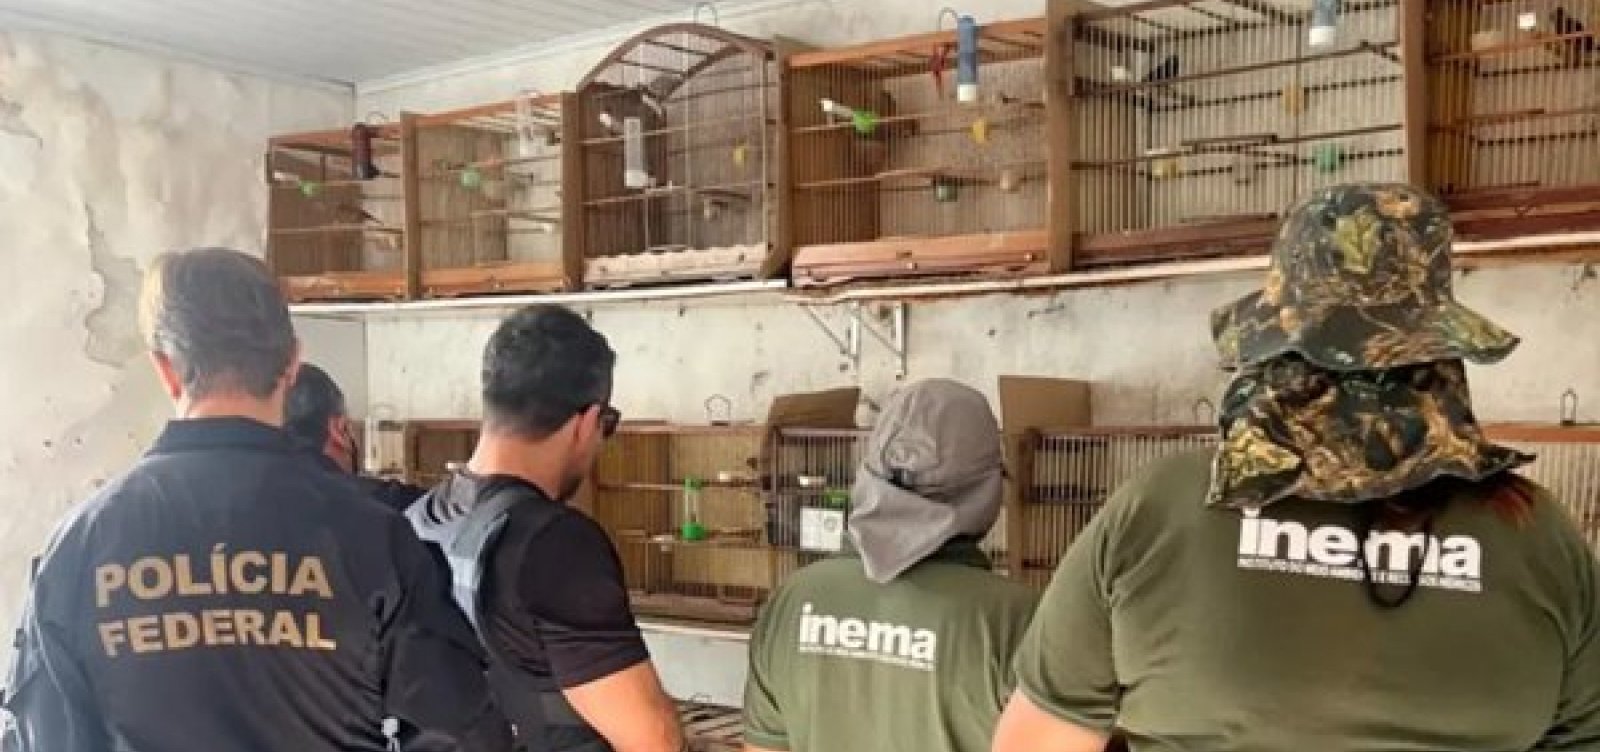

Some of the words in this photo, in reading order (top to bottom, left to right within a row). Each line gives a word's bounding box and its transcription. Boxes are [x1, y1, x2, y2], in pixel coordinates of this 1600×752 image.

[1239, 507, 1481, 579] inema
[95, 542, 333, 607] POLÍCIA
[98, 609, 337, 657] FEDERAL
[799, 602, 936, 661] inema
